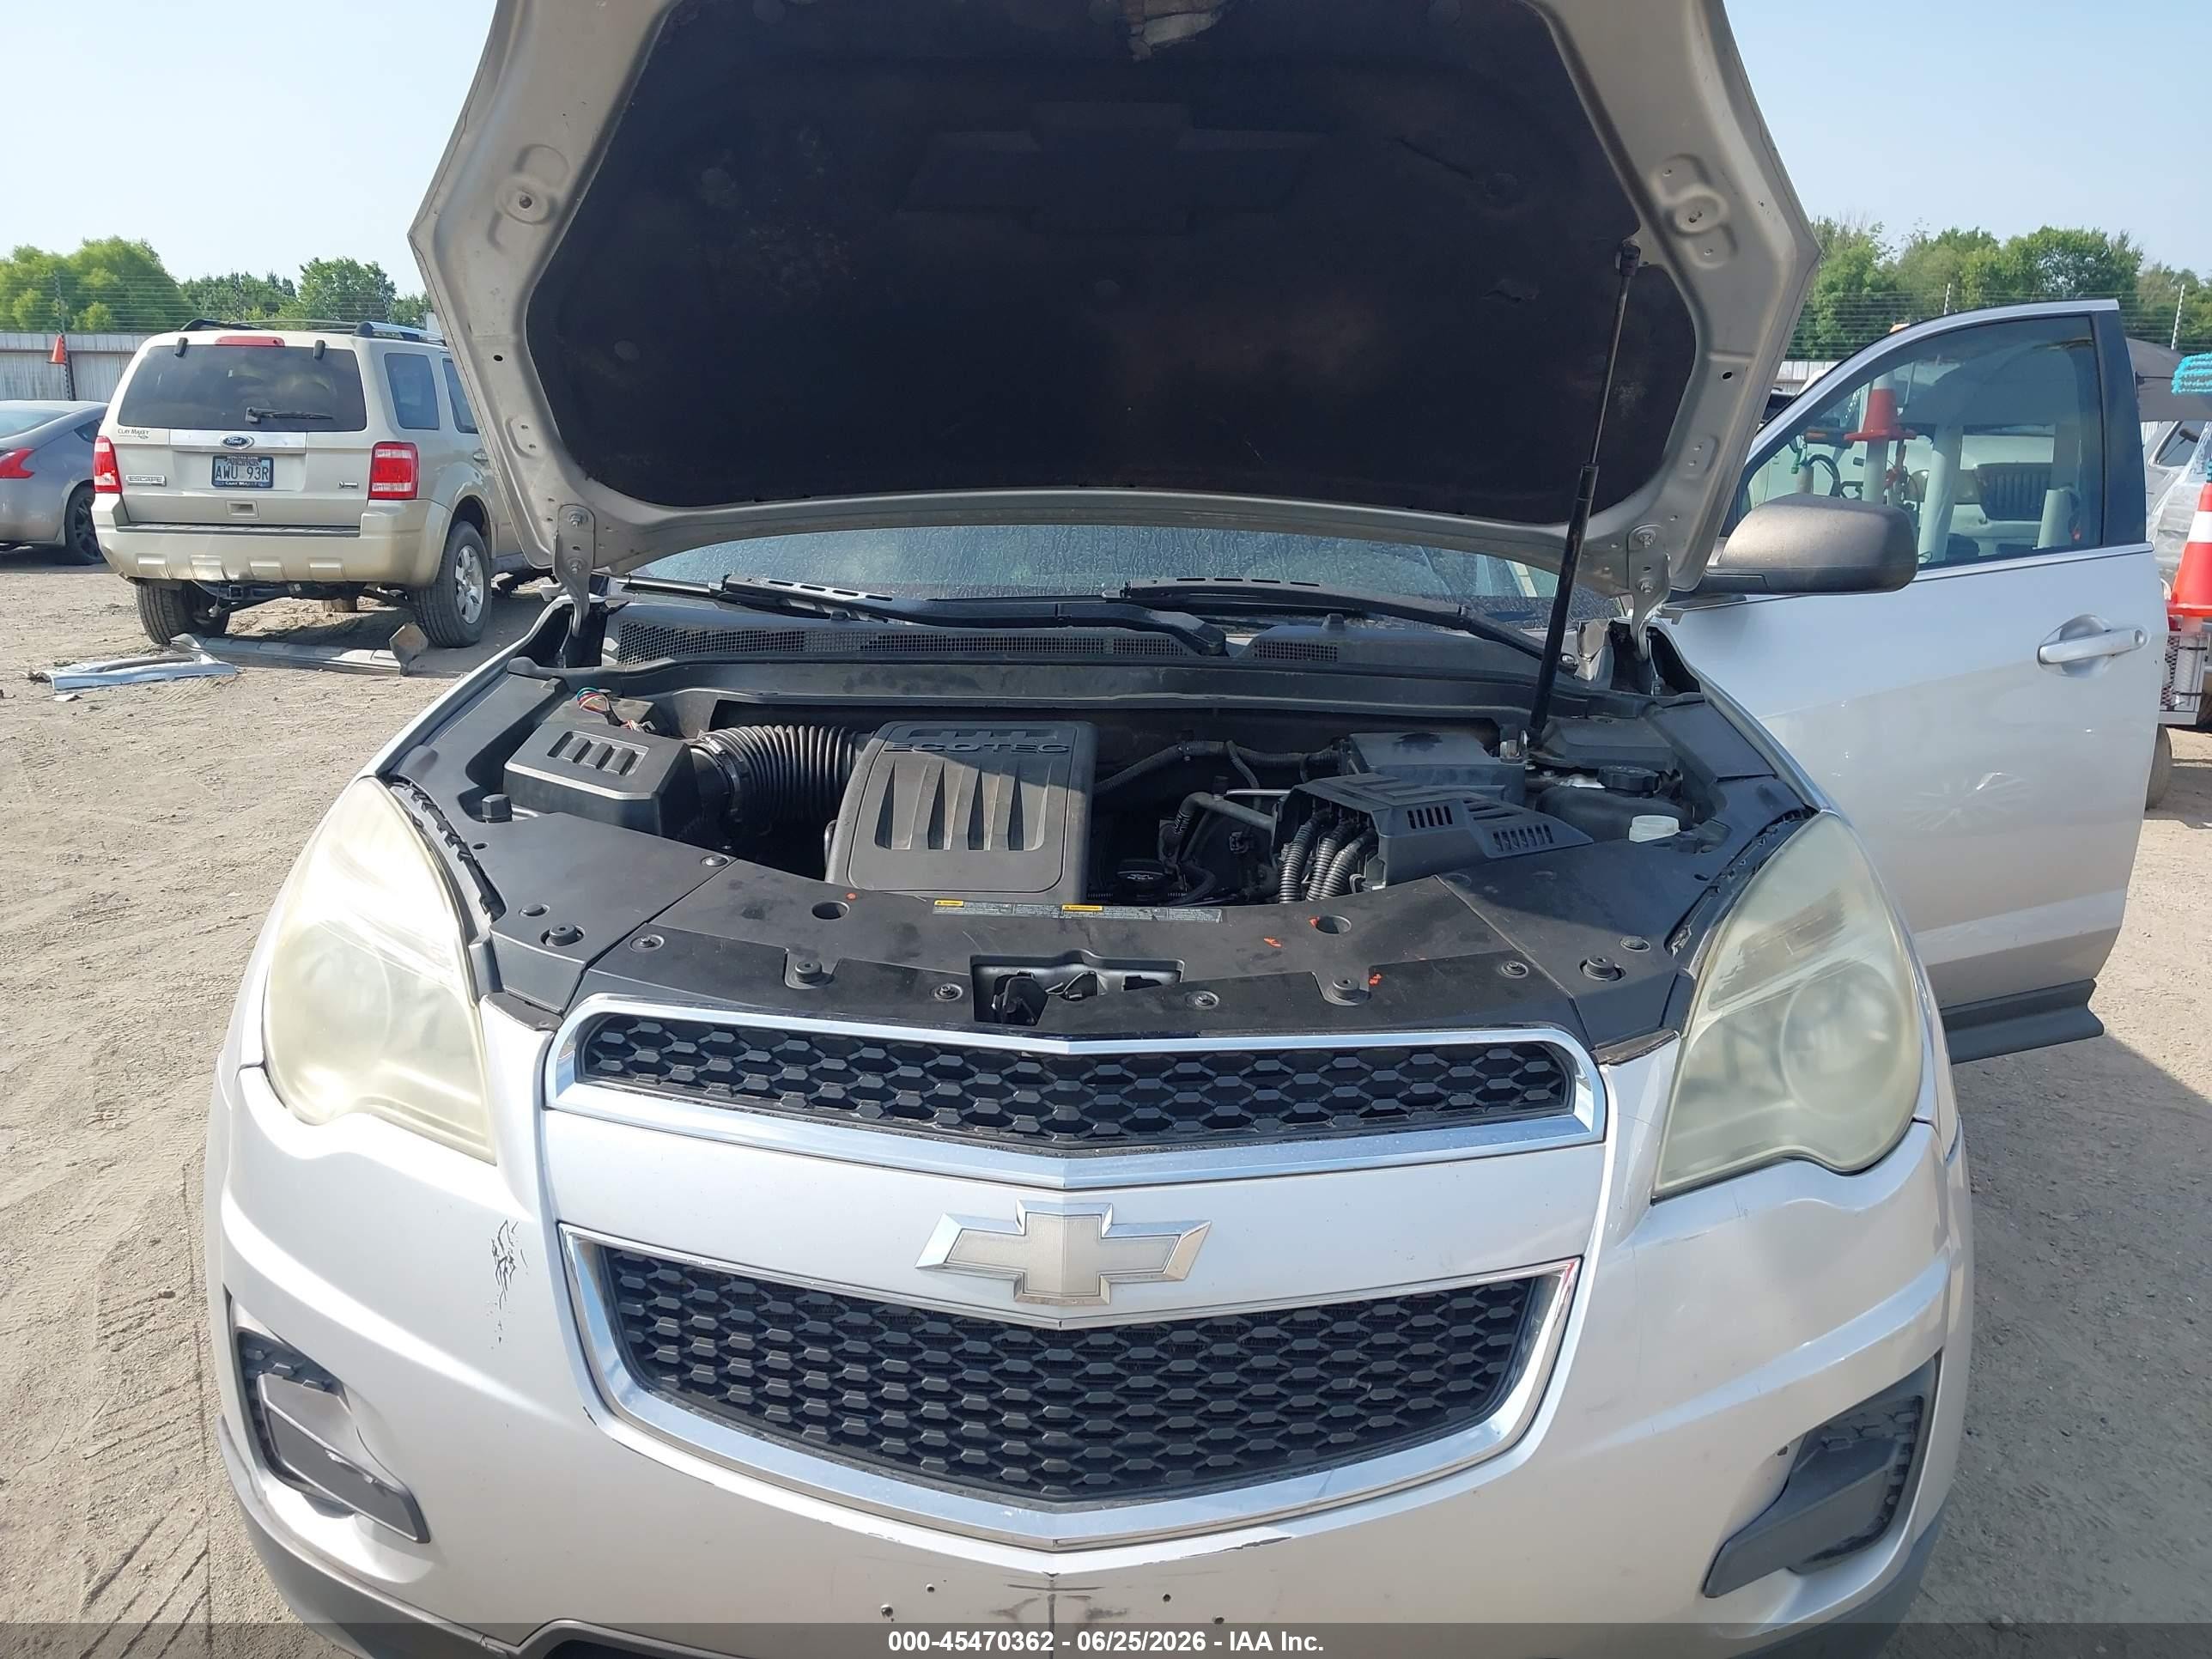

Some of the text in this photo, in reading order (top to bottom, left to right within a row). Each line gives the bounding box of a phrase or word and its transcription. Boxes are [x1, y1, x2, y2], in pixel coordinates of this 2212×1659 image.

[216, 465, 269, 481] AWU 93R
[884, 743, 1069, 754] ECOTEC
